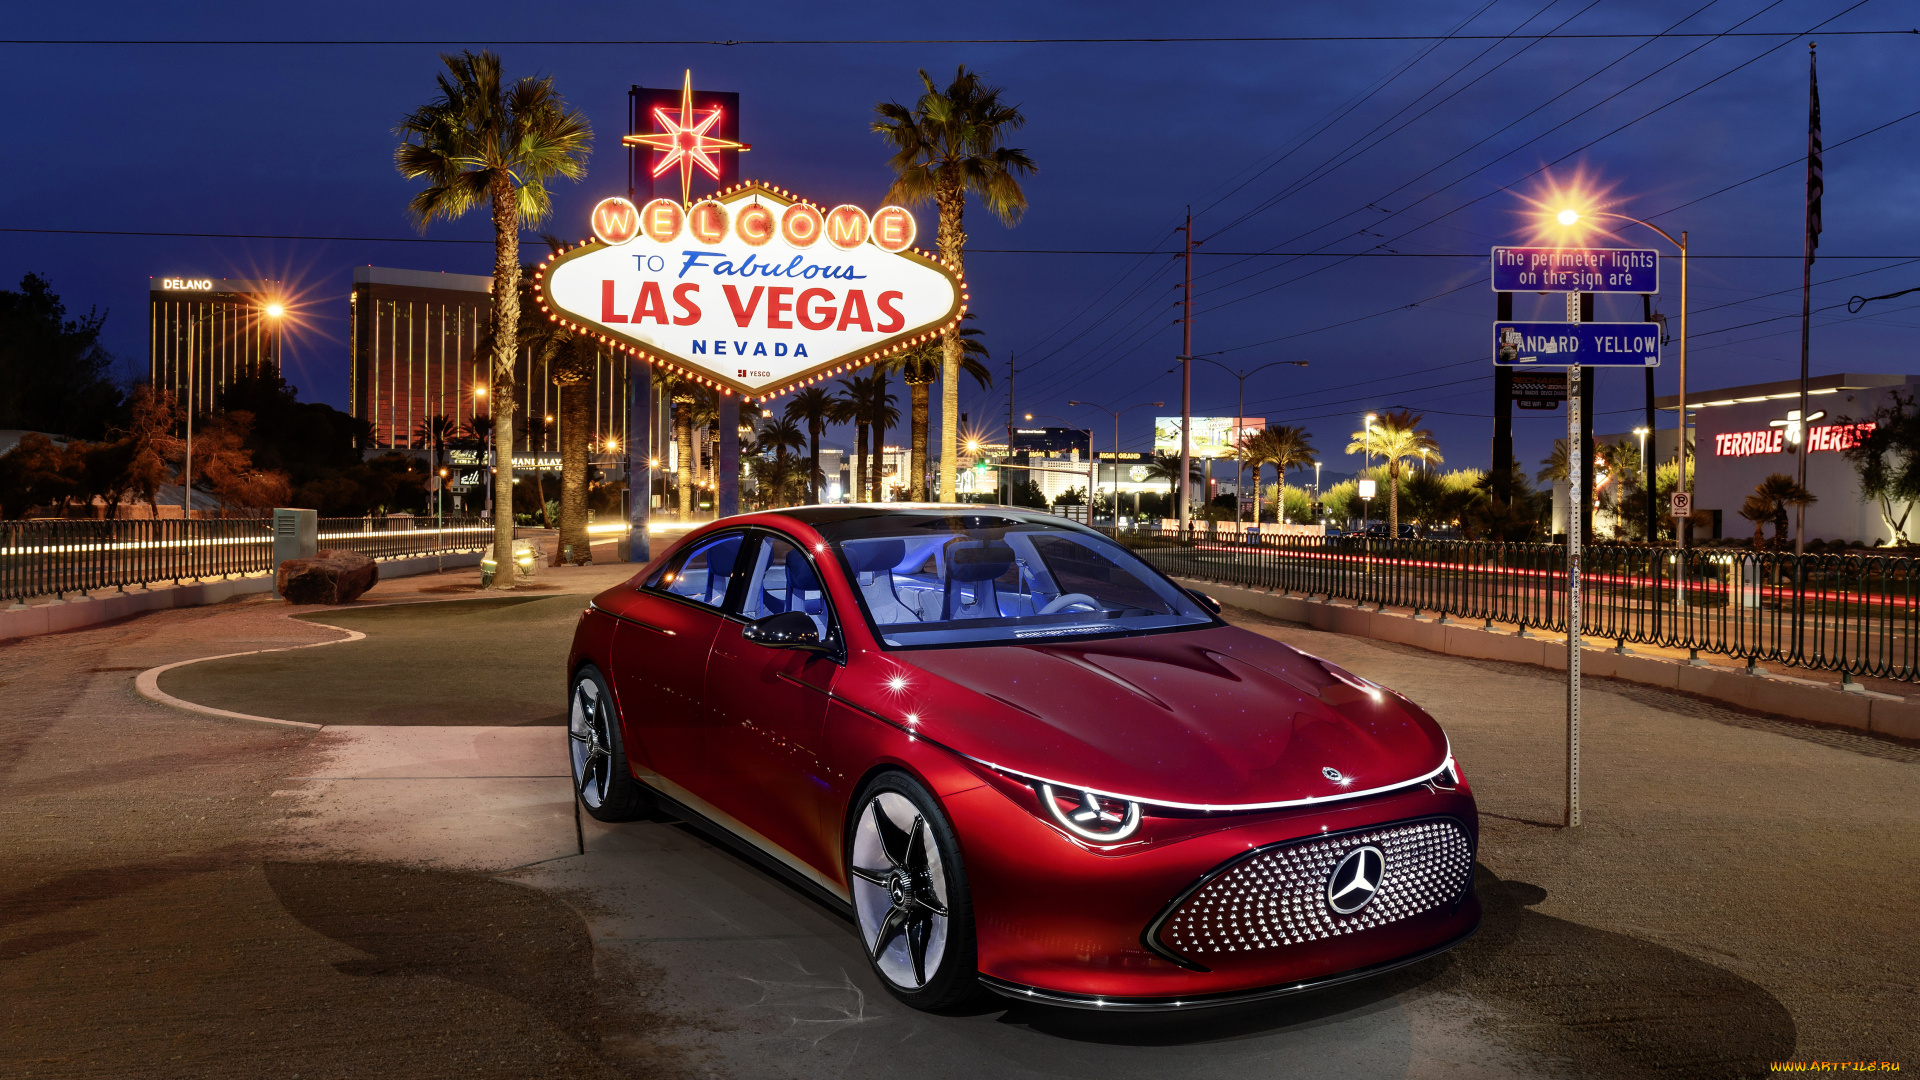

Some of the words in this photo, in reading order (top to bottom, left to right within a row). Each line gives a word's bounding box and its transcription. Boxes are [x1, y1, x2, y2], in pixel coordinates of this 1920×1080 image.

[598, 202, 907, 246] WELCOME
[632, 254, 665, 273] TO
[678, 250, 868, 280] Fabulous
[1498, 250, 1524, 266] The
[1531, 251, 1606, 271] perimeter
[1612, 251, 1654, 272] lights
[163, 279, 213, 290] DELANO
[1519, 271, 1537, 285] on
[1543, 270, 1567, 285] the
[1572, 269, 1603, 290] sign
[1609, 273, 1632, 286] are
[601, 279, 702, 326] LAS
[721, 284, 906, 334] VEGAS
[692, 340, 809, 358] NEVADA
[1594, 336, 1656, 353] YELLOW
[749, 370, 771, 378] YESCO
[1715, 429, 1784, 457] TERRIBLE
